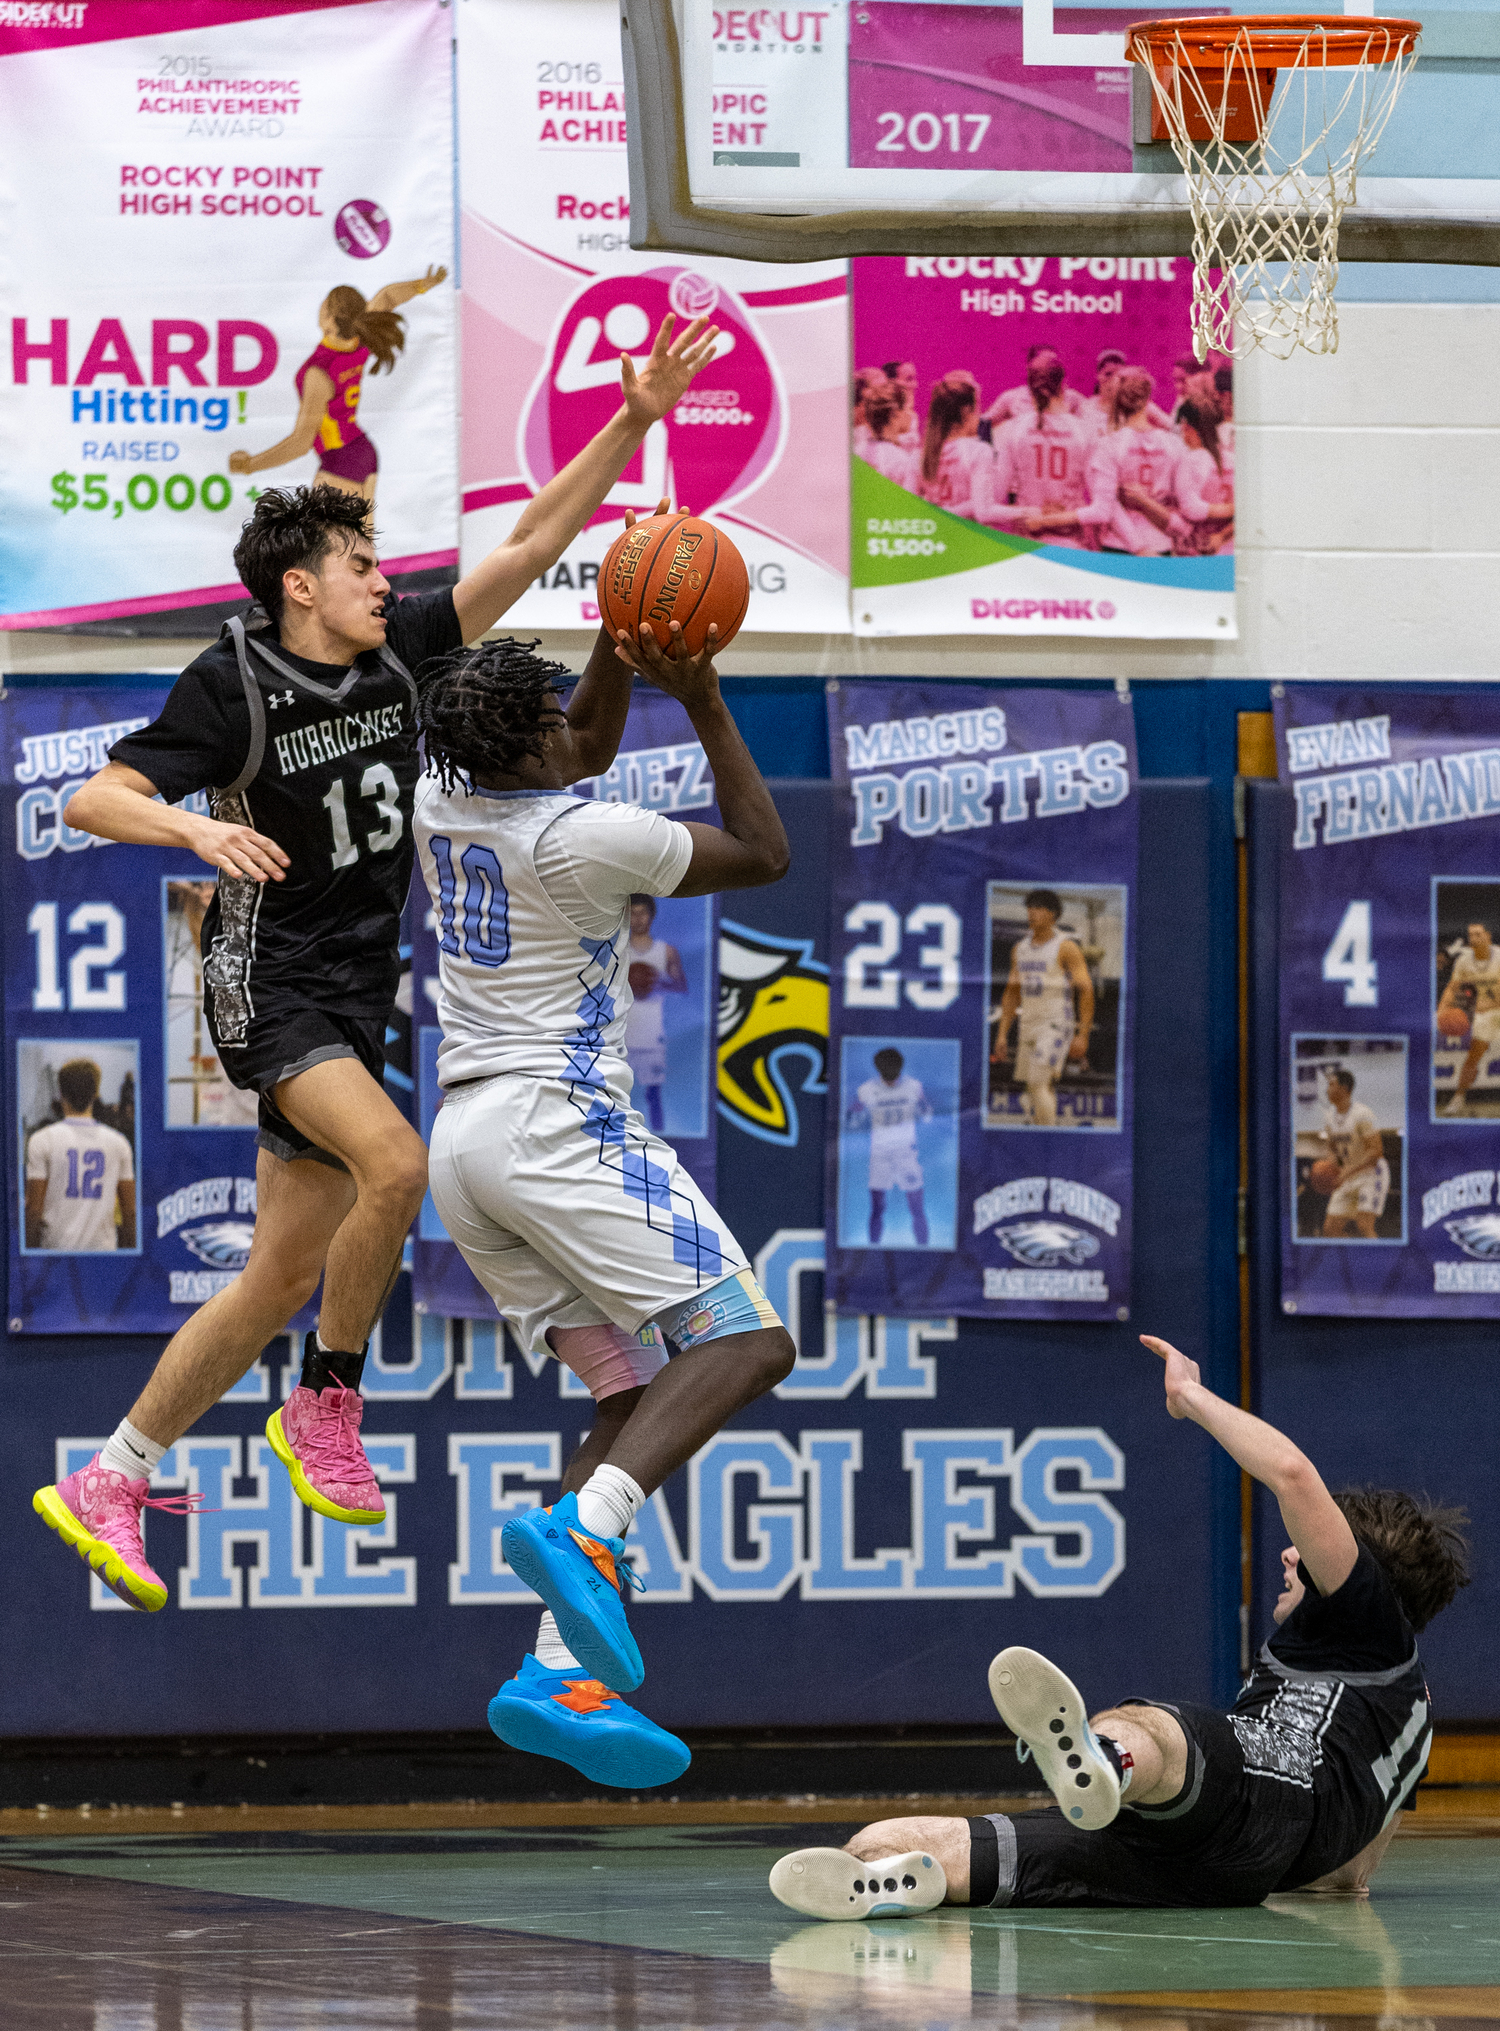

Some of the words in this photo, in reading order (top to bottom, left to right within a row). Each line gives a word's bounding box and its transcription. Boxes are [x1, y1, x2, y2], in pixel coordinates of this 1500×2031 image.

[136, 78, 301, 95] PHILANTHROPIC
[157, 55, 213, 78] 2015
[537, 61, 602, 85] 2016
[137, 97, 301, 115] ACHIEVEMENT
[185, 118, 286, 139] AWARD
[875, 112, 992, 153] 2017
[119, 166, 224, 188] ROCKY
[233, 167, 323, 189] POINT
[119, 194, 192, 217] HIGH
[201, 195, 323, 218] SCHOOL
[904, 257, 1046, 287] Rocky
[1059, 257, 1177, 282] Point
[960, 288, 1025, 317] High
[1031, 288, 1123, 315] School
[12, 317, 280, 388] HARD
[681, 389, 740, 407] AISED
[81, 441, 180, 462] RAISED
[50, 470, 233, 519] $5,000
[867, 518, 938, 535] RAISED
[620, 525, 662, 606] LEGACY
[648, 527, 705, 625] SPALDING
[971, 599, 1095, 620] DIGPINK
[14, 716, 150, 784] JUST
[844, 706, 1008, 769] MARCUS
[1286, 714, 1392, 773] EVAN
[322, 761, 404, 871] 13
[851, 740, 1130, 847] PORTES
[428, 833, 512, 969] 10
[27, 901, 127, 1012] 12
[844, 900, 963, 1010] 23
[1322, 900, 1378, 1007] 4
[66, 1149, 106, 1200] 12
[56, 1434, 417, 1611] THE
